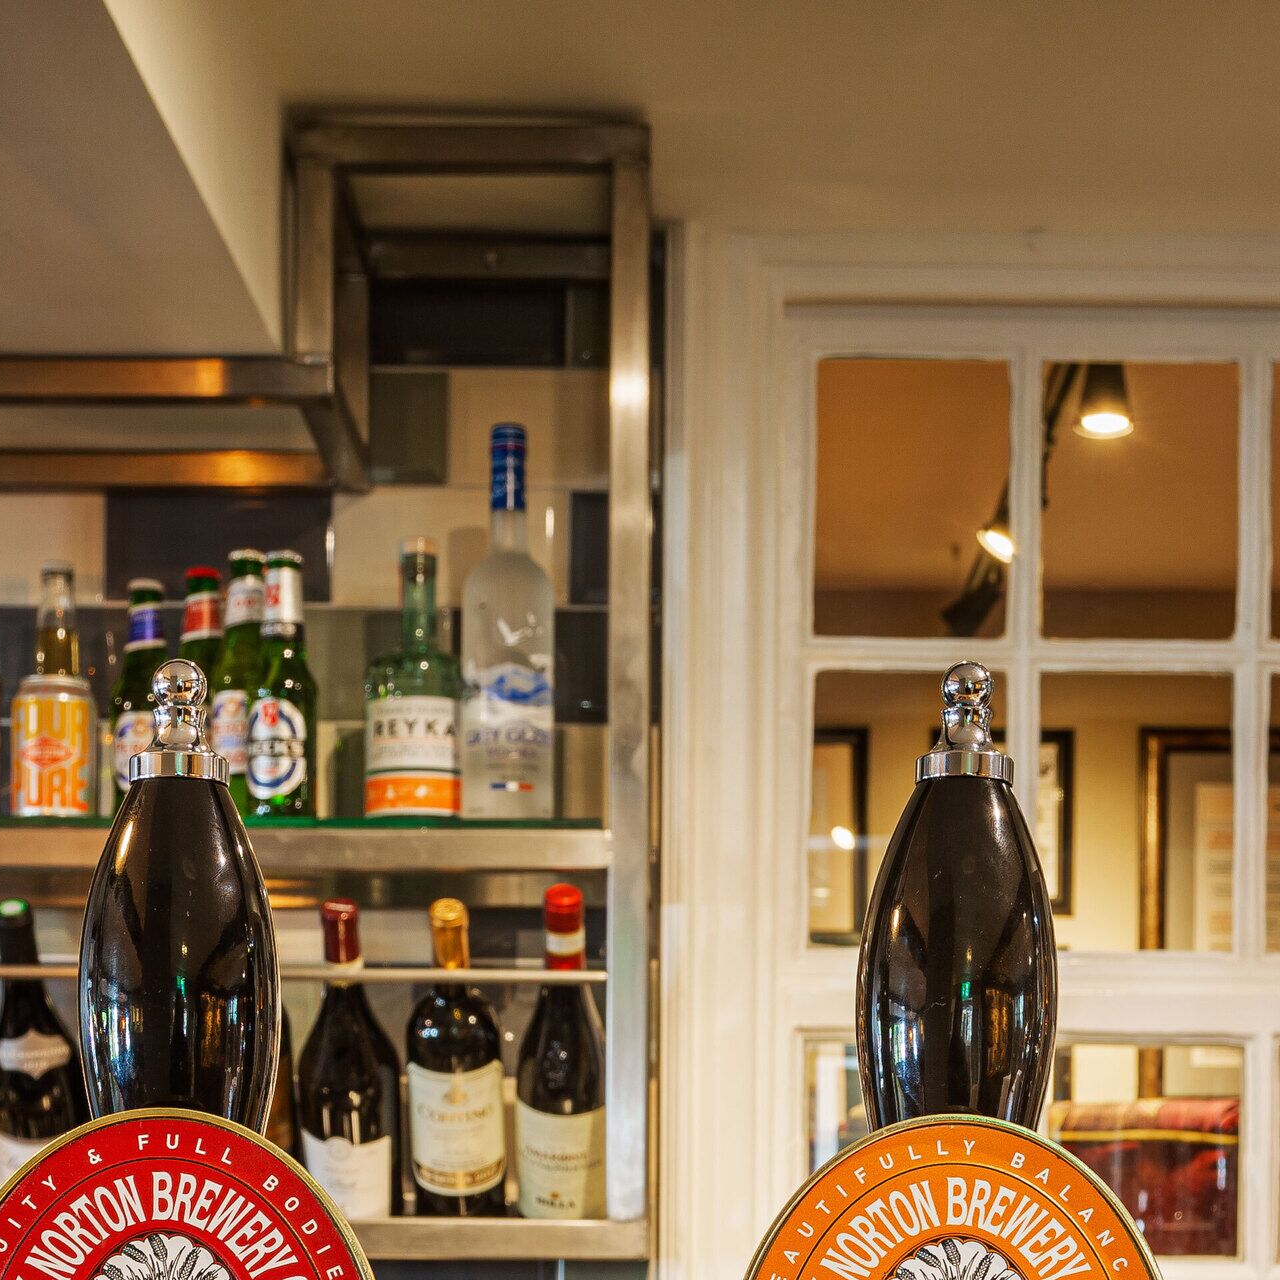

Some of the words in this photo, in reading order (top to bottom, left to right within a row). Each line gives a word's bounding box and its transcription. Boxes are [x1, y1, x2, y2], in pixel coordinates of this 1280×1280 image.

[373, 719, 456, 737] REYKA
[88, 1149, 102, 1164] &
[138, 1134, 232, 1165] FULL
[152, 1172, 298, 1279] BREWERY
